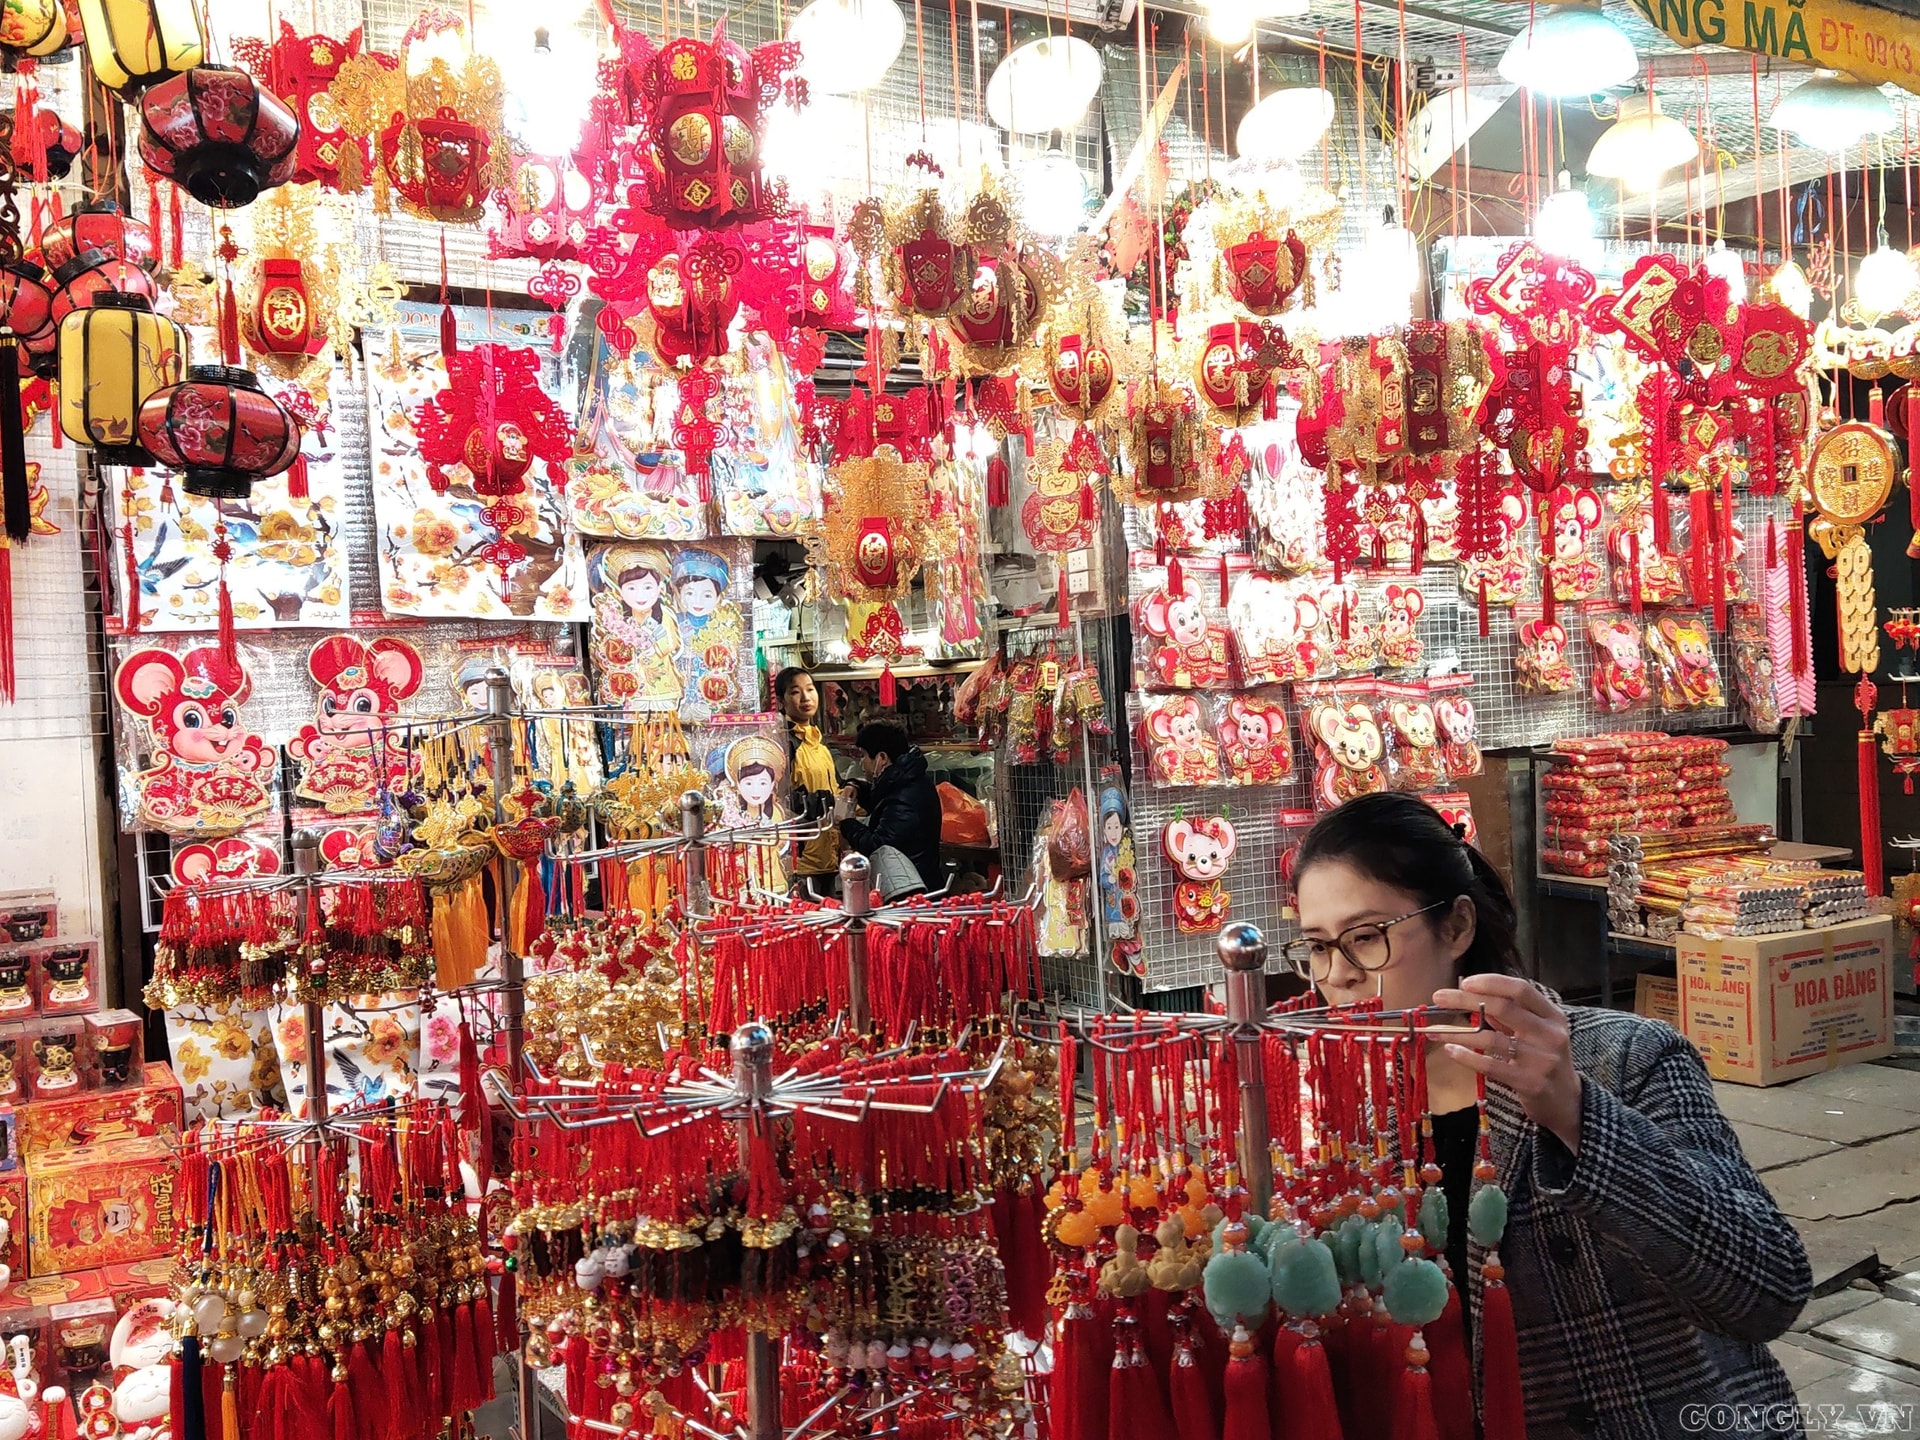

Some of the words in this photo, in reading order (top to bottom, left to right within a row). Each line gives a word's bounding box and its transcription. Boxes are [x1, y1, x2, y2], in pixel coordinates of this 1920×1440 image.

[1744, 0, 1813, 58] MÃ
[399, 310, 437, 329] OOM
[1795, 977, 1829, 1009] HOA
